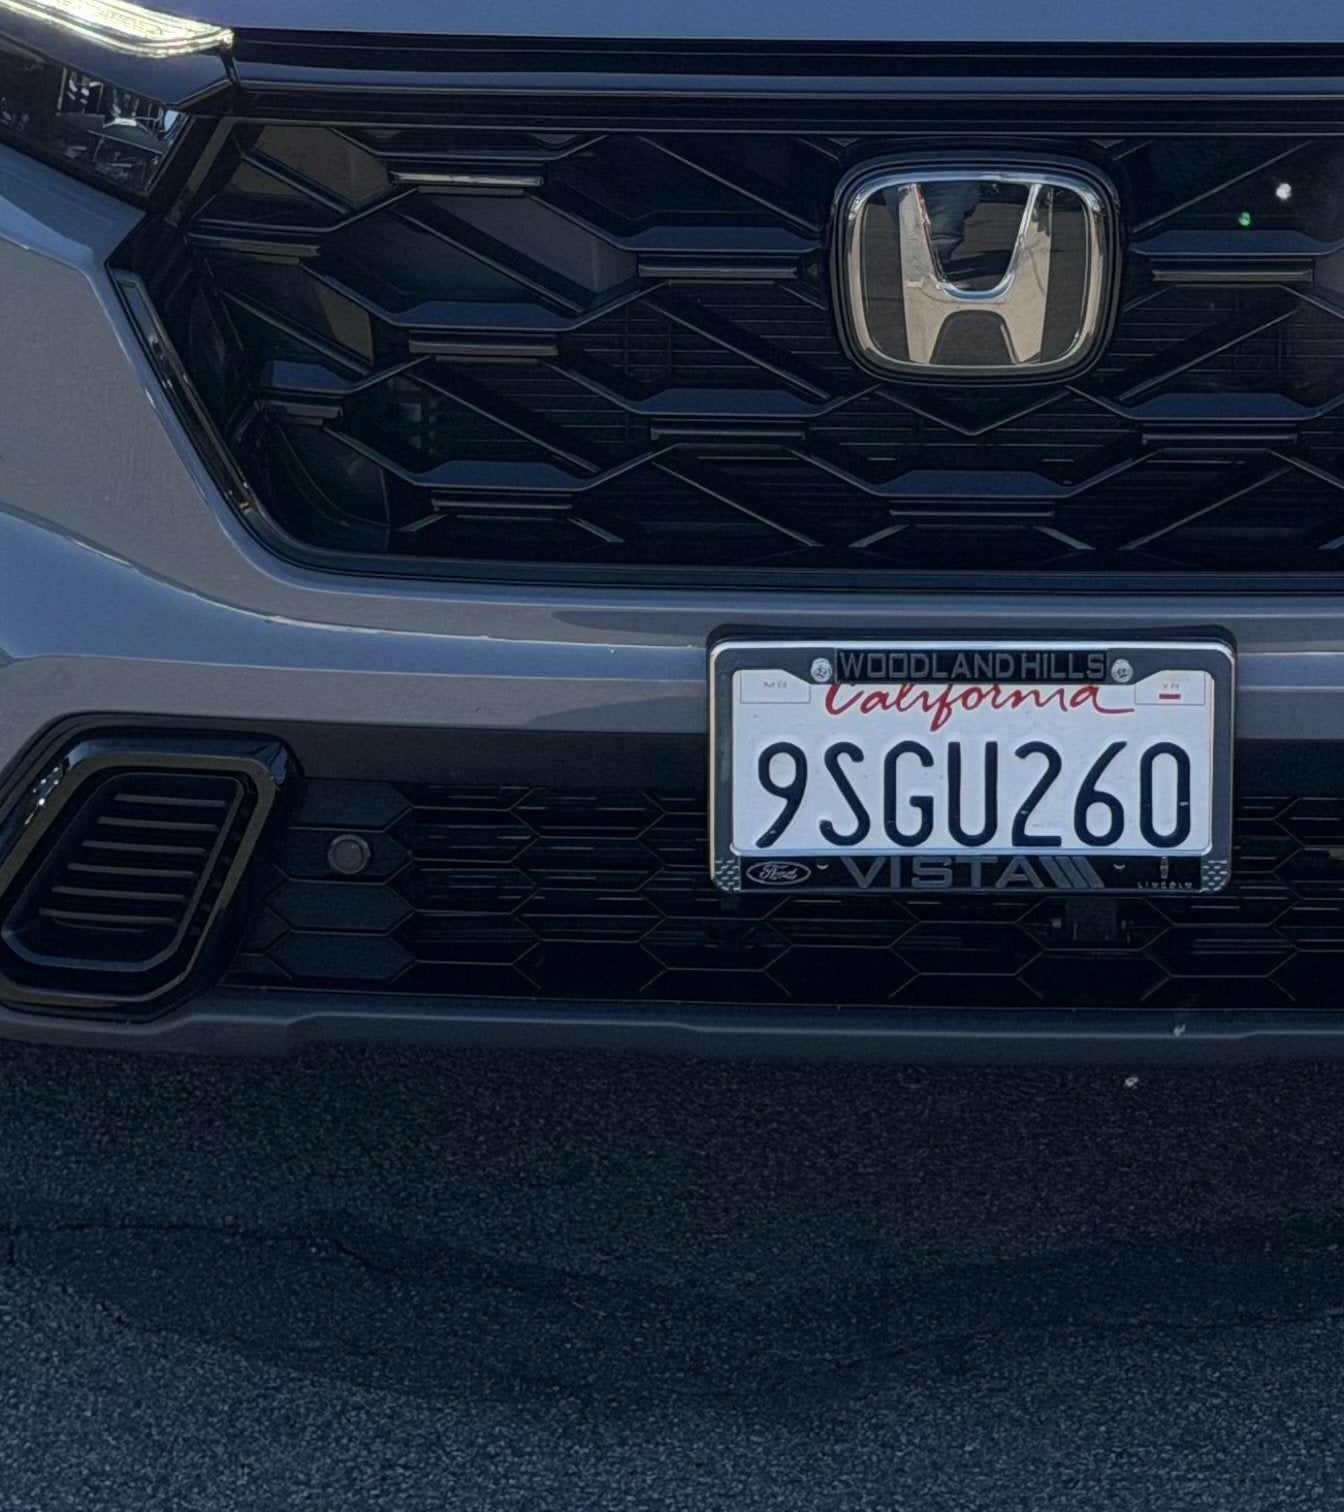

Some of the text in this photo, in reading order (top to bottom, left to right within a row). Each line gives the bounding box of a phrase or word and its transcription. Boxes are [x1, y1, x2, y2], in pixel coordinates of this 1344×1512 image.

[839, 652, 1105, 679] WOODLAND HILLS
[824, 683, 1135, 732] California
[756, 741, 1191, 848] 9SGU260
[841, 856, 1045, 888] VISTA
